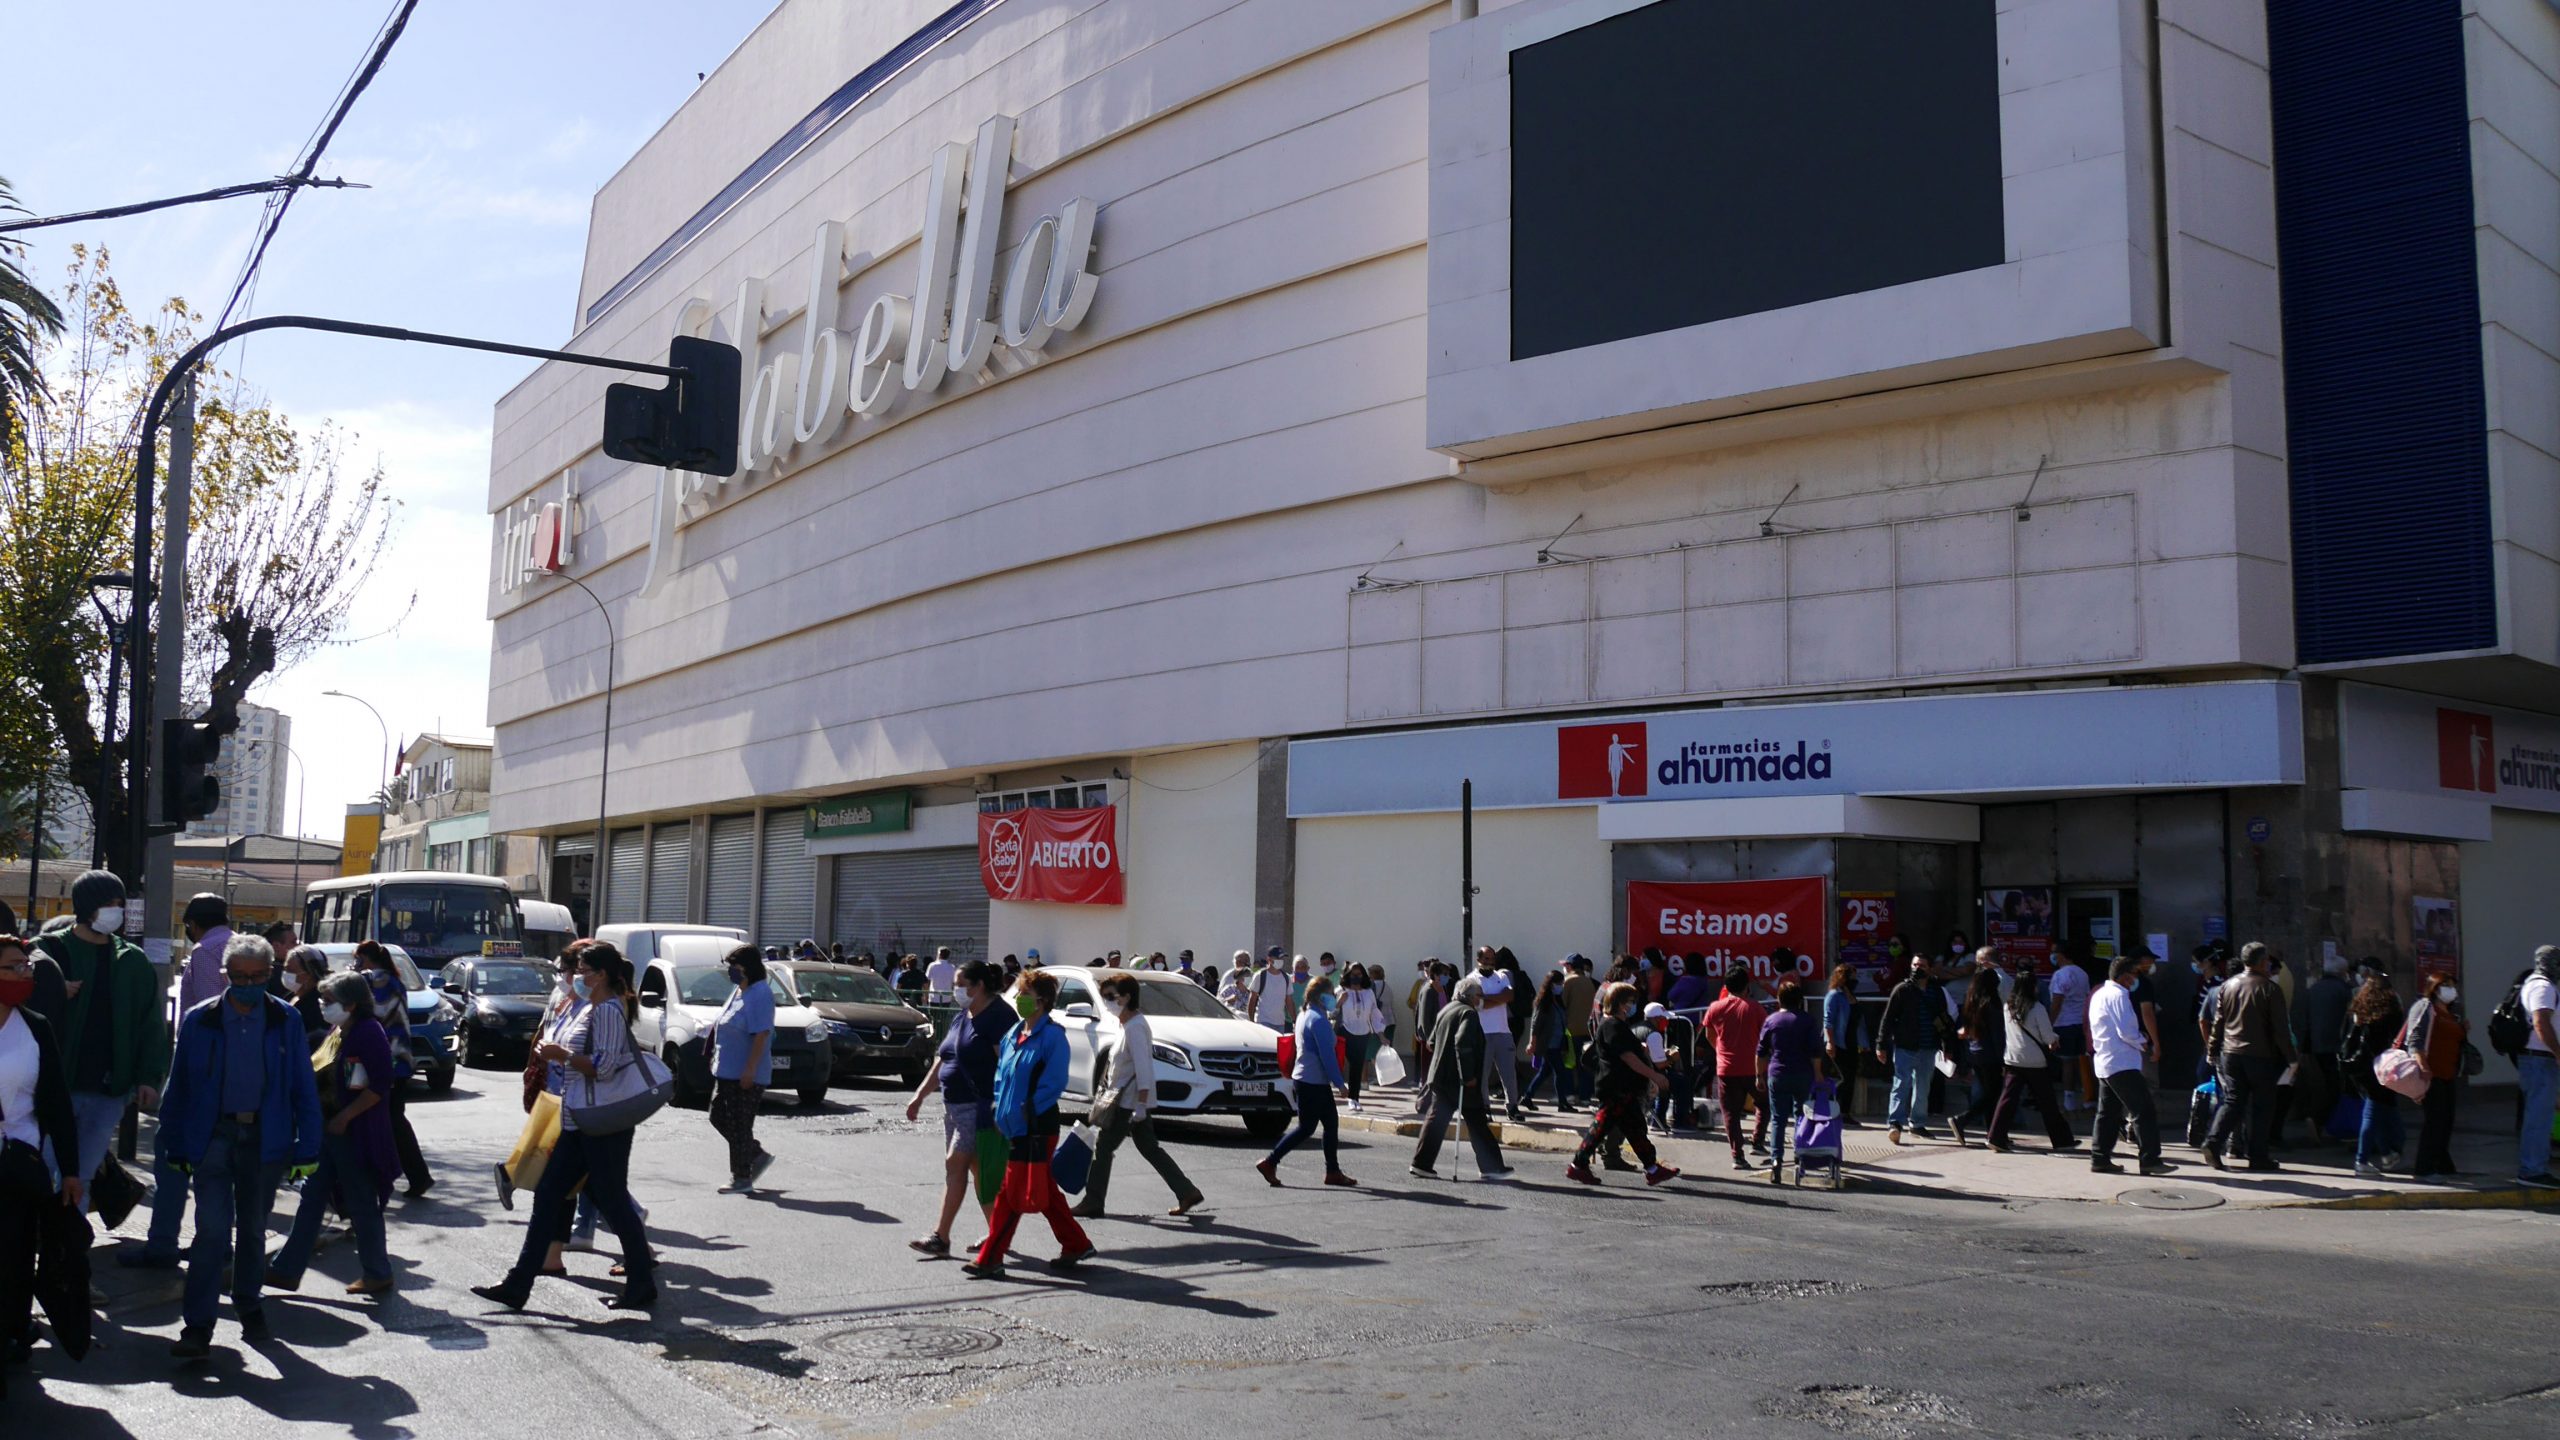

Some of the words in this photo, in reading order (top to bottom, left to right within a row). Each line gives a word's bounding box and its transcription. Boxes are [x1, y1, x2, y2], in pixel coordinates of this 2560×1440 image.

[638, 114, 1100, 599] flabella
[1690, 738, 1781, 756] farmacias
[1657, 740, 1832, 786] ahumada
[817, 811, 838, 828] Banco
[1029, 841, 1111, 869] ABIERTO
[1659, 907, 1789, 936] Estamos
